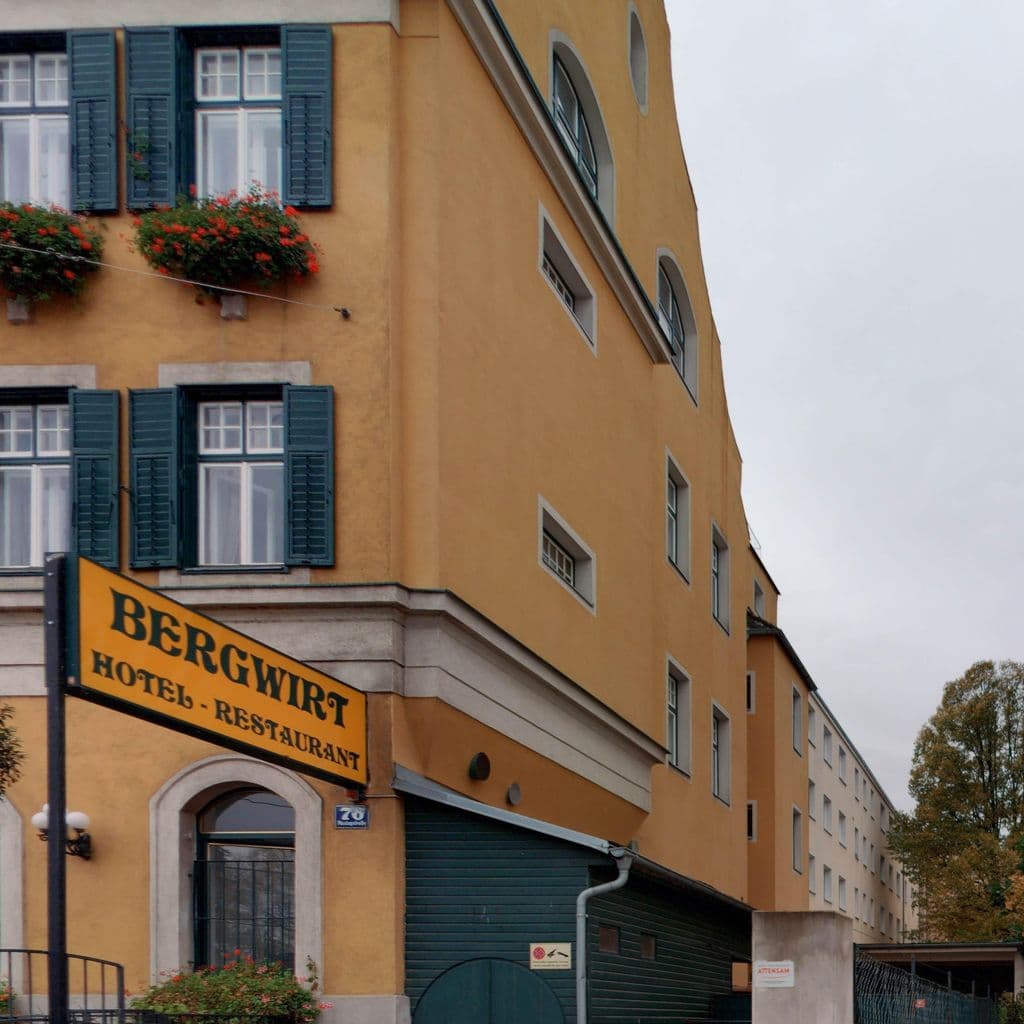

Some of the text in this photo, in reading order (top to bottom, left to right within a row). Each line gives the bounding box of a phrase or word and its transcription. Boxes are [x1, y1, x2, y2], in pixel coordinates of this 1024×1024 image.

[91, 649, 194, 710] HOTEL
[213, 697, 361, 772] RESTAURANT
[109, 587, 349, 728] BERGWIRT
